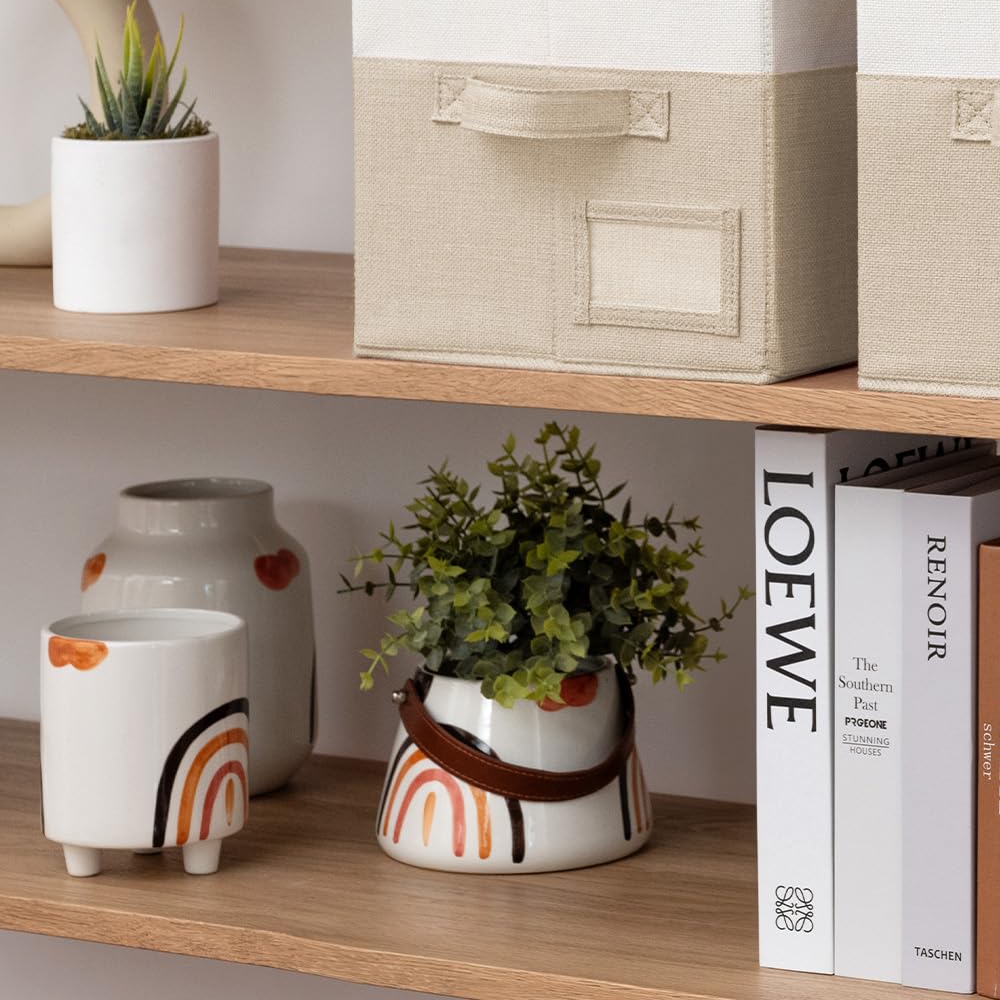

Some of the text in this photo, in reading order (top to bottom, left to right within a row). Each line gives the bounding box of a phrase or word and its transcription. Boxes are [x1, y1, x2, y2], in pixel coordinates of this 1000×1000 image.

[763, 468, 818, 734] LOEWE
[927, 534, 948, 662] RENOIR
[852, 656, 878, 672] The
[838, 675, 894, 693] Southern
[853, 696, 878, 711] Past
[842, 733, 890, 746] STUNNING
[849, 746, 882, 757] HOUSES
[983, 723, 995, 780] schwer
[914, 946, 962, 962] TASCHEN
